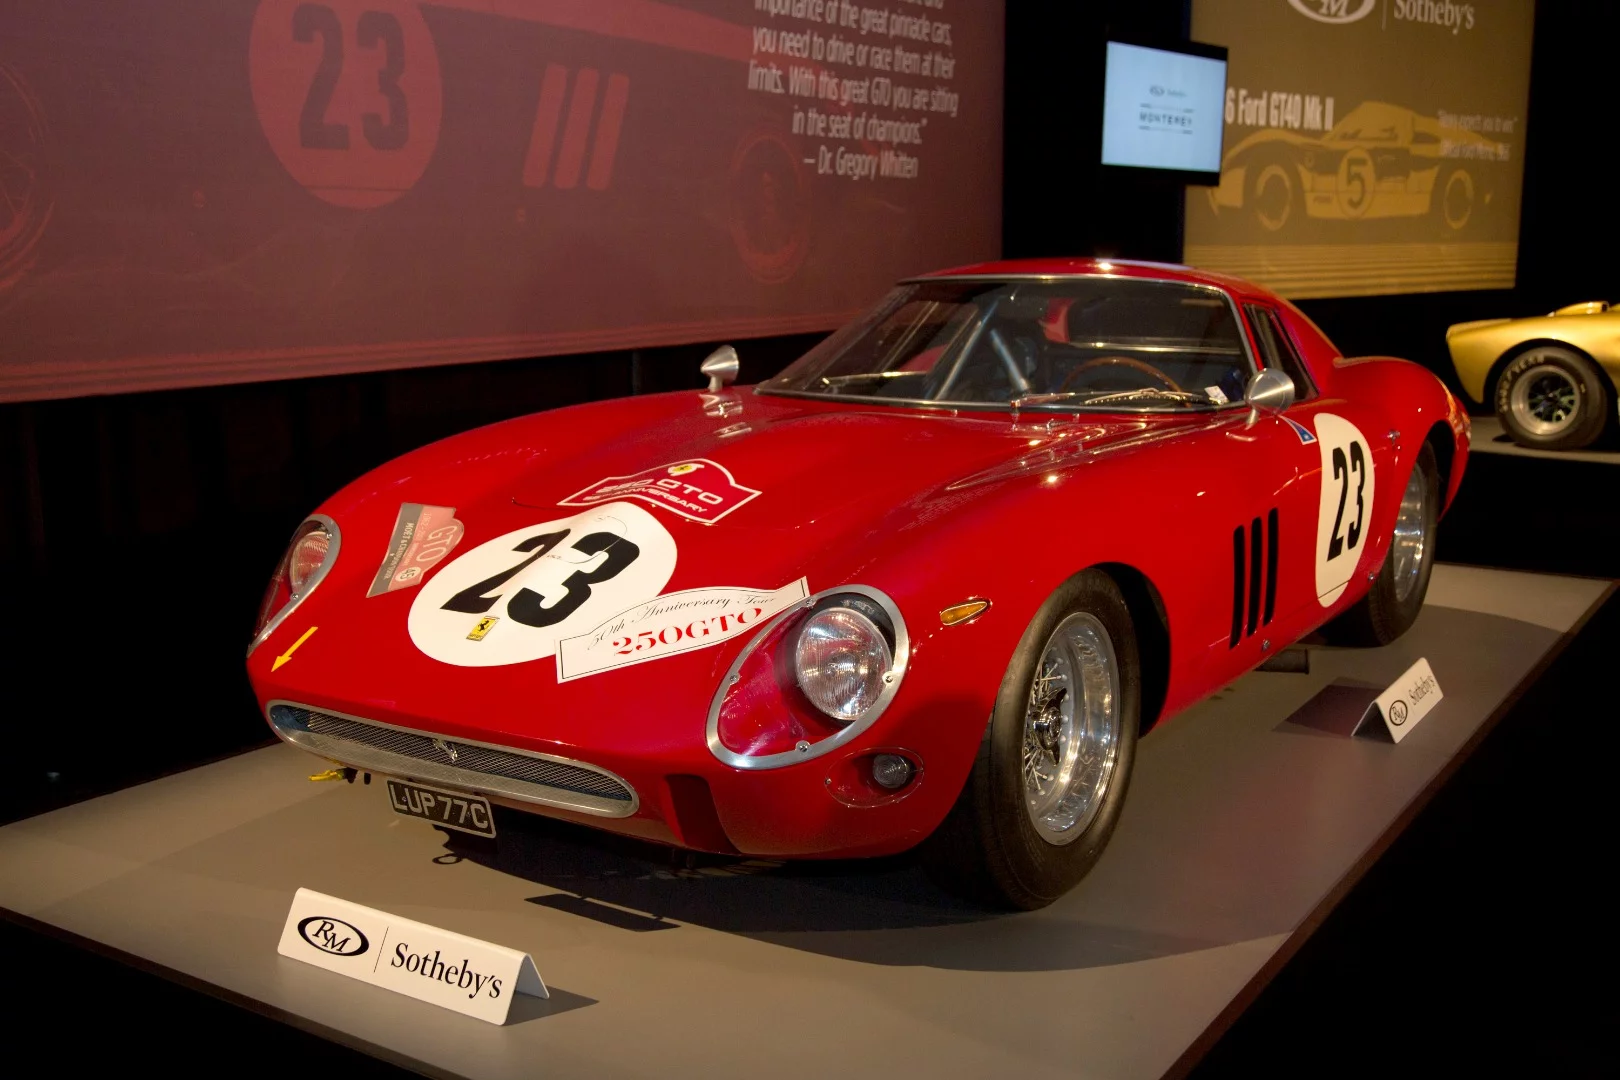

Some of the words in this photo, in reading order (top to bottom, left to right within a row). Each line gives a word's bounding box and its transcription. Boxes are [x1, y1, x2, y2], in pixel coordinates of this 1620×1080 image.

[825, 0, 839, 24] of
[840, 1, 859, 29] the
[860, 7, 887, 36] great
[1394, 0, 1475, 35] Sotheby's
[753, 26, 777, 55] you
[779, 28, 811, 59] need
[812, 35, 825, 61] to
[826, 35, 855, 66] drive
[856, 43, 869, 67] or
[870, 45, 893, 73] race
[894, 46, 920, 75] them
[921, 52, 933, 78] at
[934, 49, 956, 79] their
[292, 4, 410, 151] 23
[748, 59, 785, 94] limits.
[788, 65, 817, 98] With
[818, 68, 841, 100] this
[841, 76, 870, 106] great
[870, 77, 891, 106] GTO
[892, 87, 912, 111] you
[913, 86, 929, 112] are
[930, 87, 959, 118] sitting
[792, 105, 806, 135] in
[806, 108, 826, 138] the
[827, 111, 852, 139] seat
[853, 112, 867, 141] of
[1237, 88, 1268, 127] Ford
[1269, 91, 1302, 130] GT40
[1303, 95, 1323, 131] Mk
[817, 144, 834, 176] Dr.
[835, 145, 880, 181] Gregory
[880, 150, 918, 178] Whitten
[1342, 158, 1368, 209] 5
[656, 477, 724, 505] GTO
[1326, 440, 1366, 562] 23
[416, 525, 458, 562] GTO
[400, 568, 417, 580] 45
[439, 528, 641, 629] 23
[587, 619, 626, 651] 50th
[631, 596, 731, 624] Anniversary
[737, 594, 776, 605] Tour
[611, 607, 763, 656] 250GTO
[1408, 675, 1436, 706] Sotheby's
[388, 782, 436, 817] LUP
[438, 798, 489, 830] 77C
[391, 942, 504, 1000] Sotheby's
